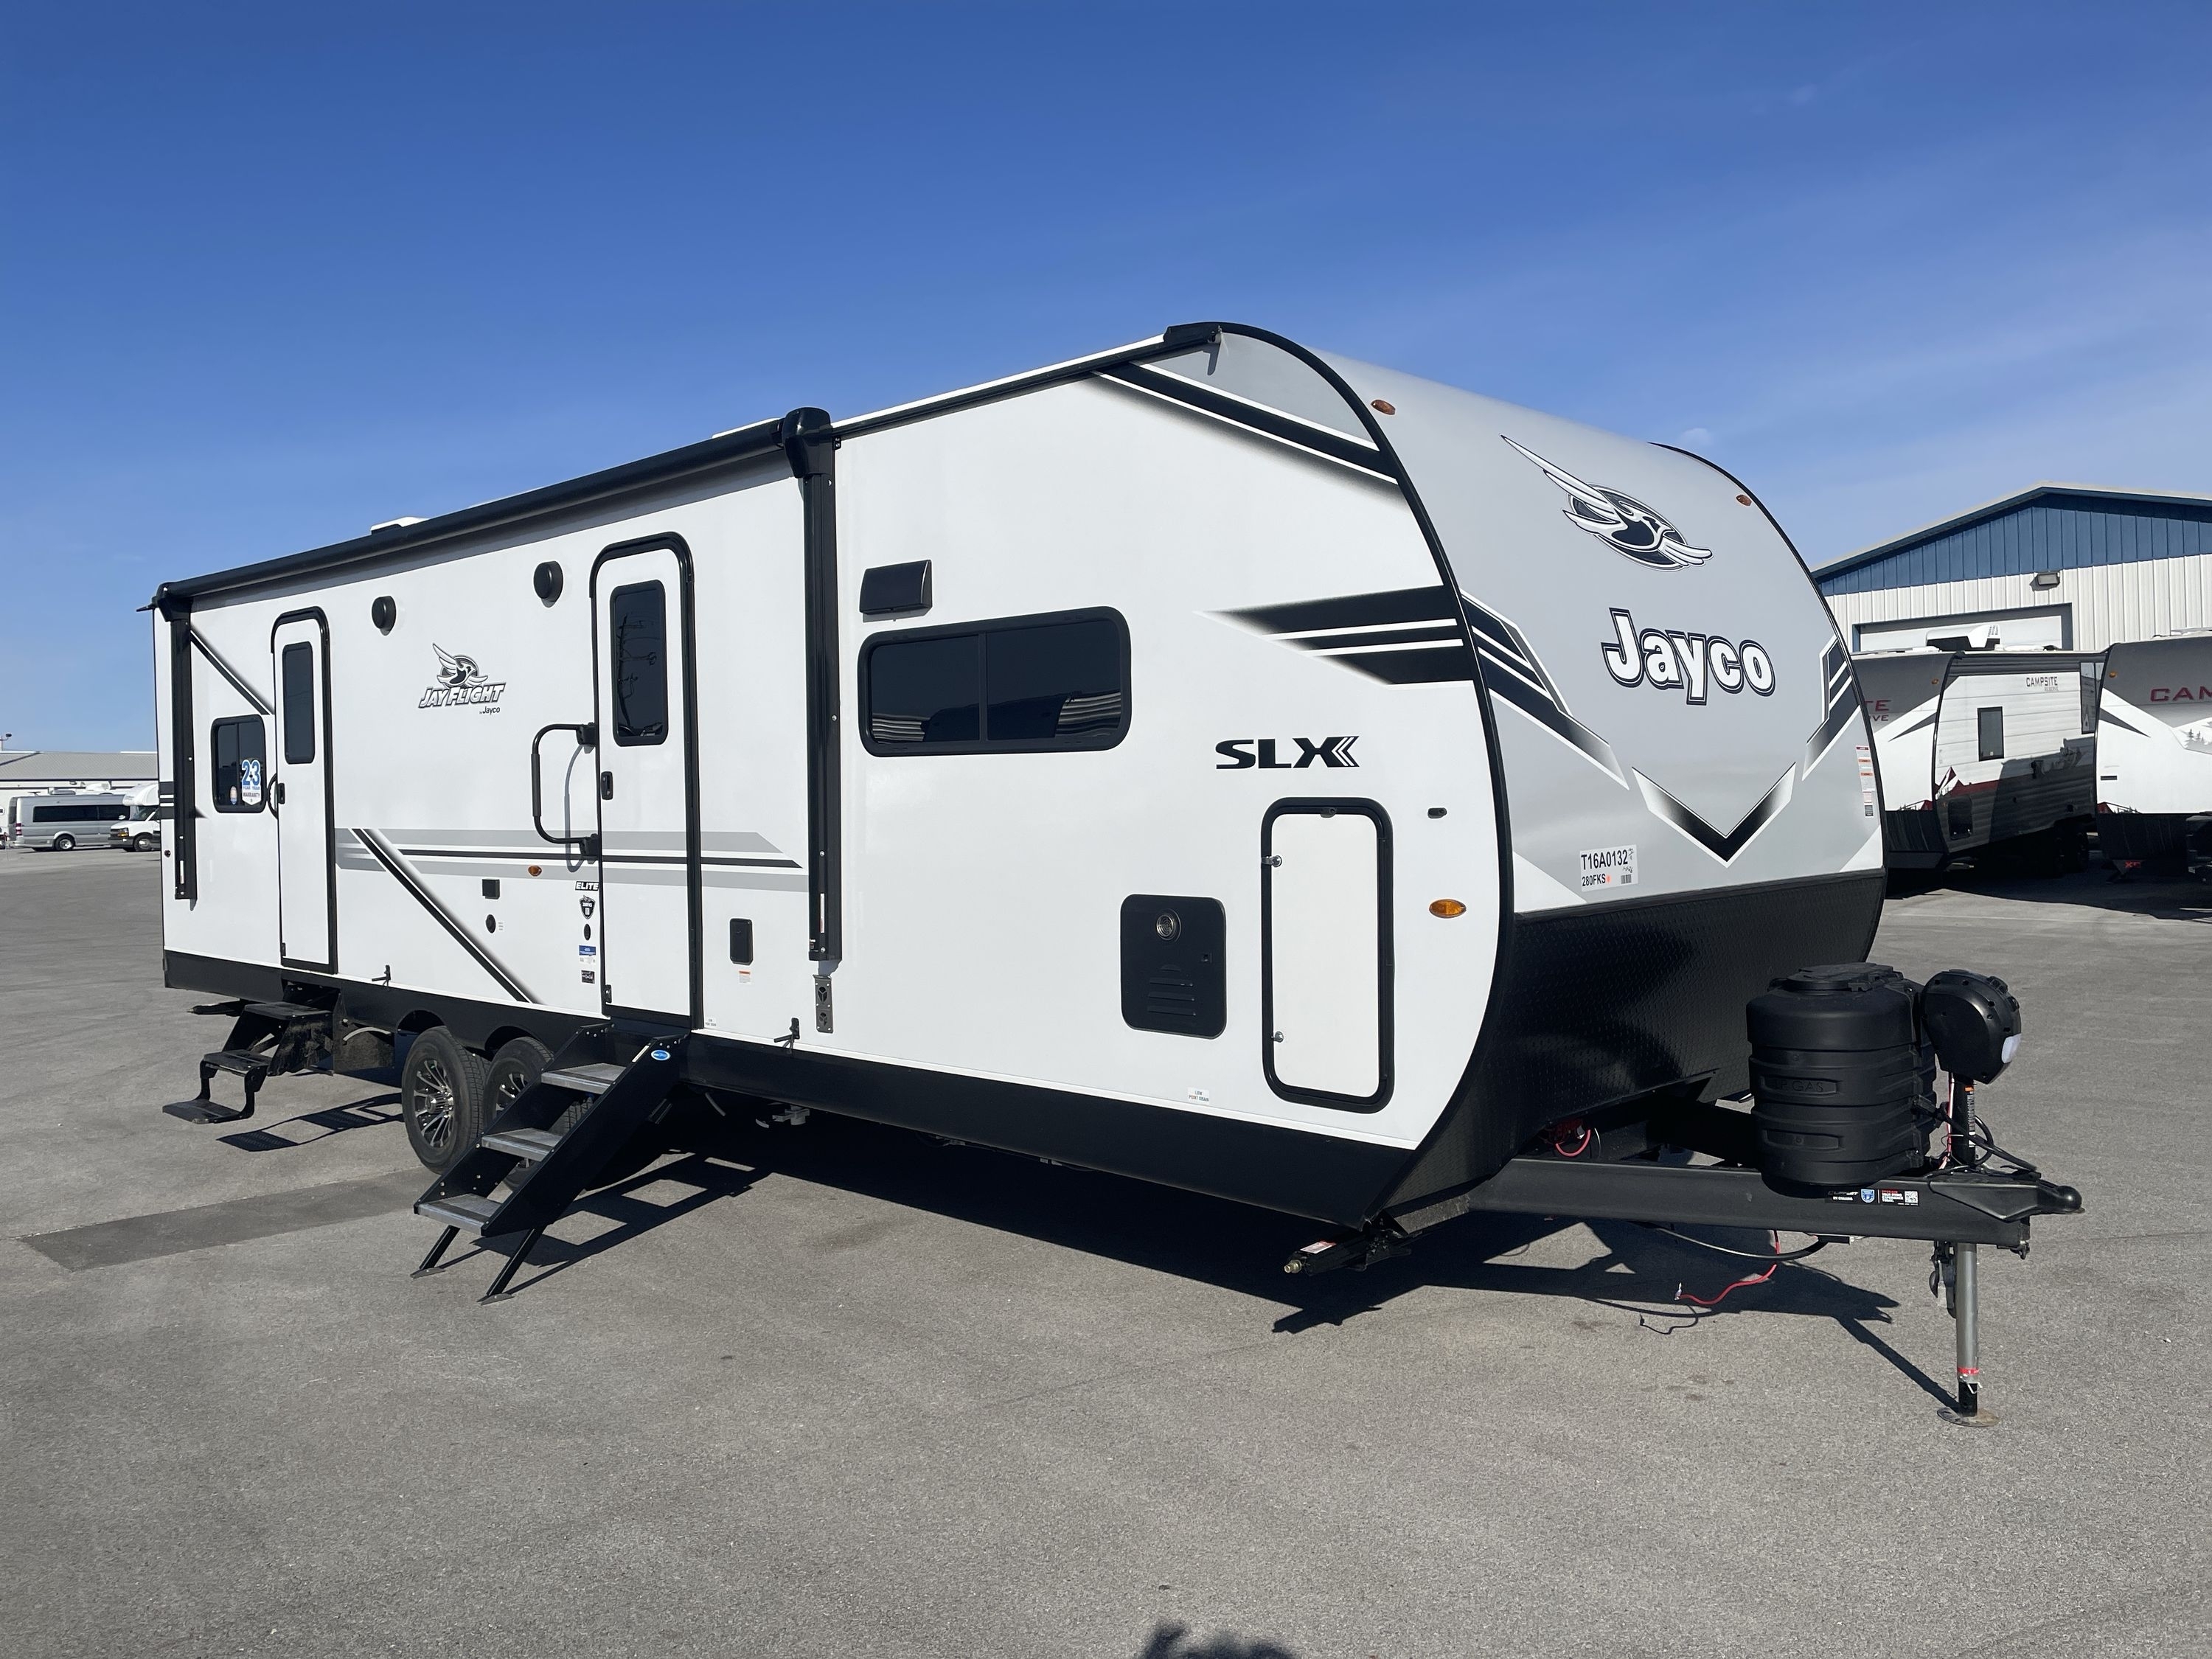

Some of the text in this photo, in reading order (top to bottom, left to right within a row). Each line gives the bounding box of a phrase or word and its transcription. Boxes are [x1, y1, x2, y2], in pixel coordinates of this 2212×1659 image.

[1601, 608, 1775, 706] Jayco
[2026, 676, 2058, 686] CAMPSITE
[482, 706, 501, 715] Jayco
[1215, 736, 1360, 769] SLX
[1581, 849, 1628, 870] T16A0132
[1582, 873, 1606, 886] 280FKS
[576, 882, 599, 890] ELITE
[1792, 1080, 1823, 1092] GAS
